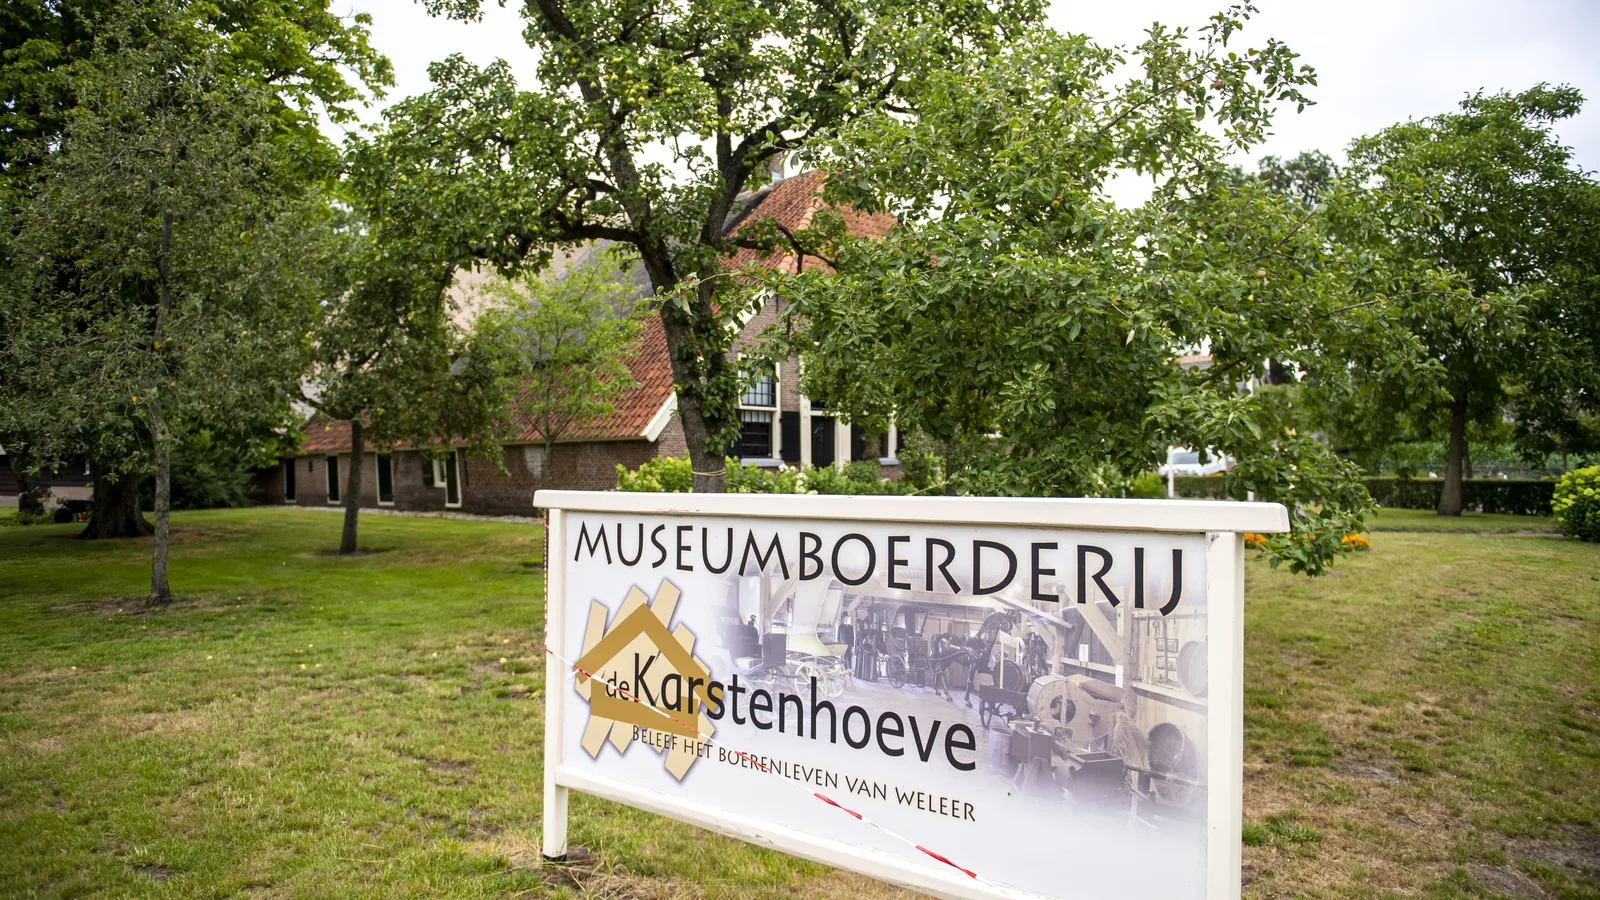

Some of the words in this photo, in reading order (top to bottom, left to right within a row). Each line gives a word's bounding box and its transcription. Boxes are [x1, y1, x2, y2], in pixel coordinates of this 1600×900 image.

[574, 520, 1183, 616] MUSEUMBOERDERIJ
[632, 725, 678, 751] BELEEF
[684, 738, 713, 759] HET
[719, 746, 839, 789] BOERENLEVEN
[845, 775, 887, 801] VAN
[895, 786, 976, 822] WELEER
